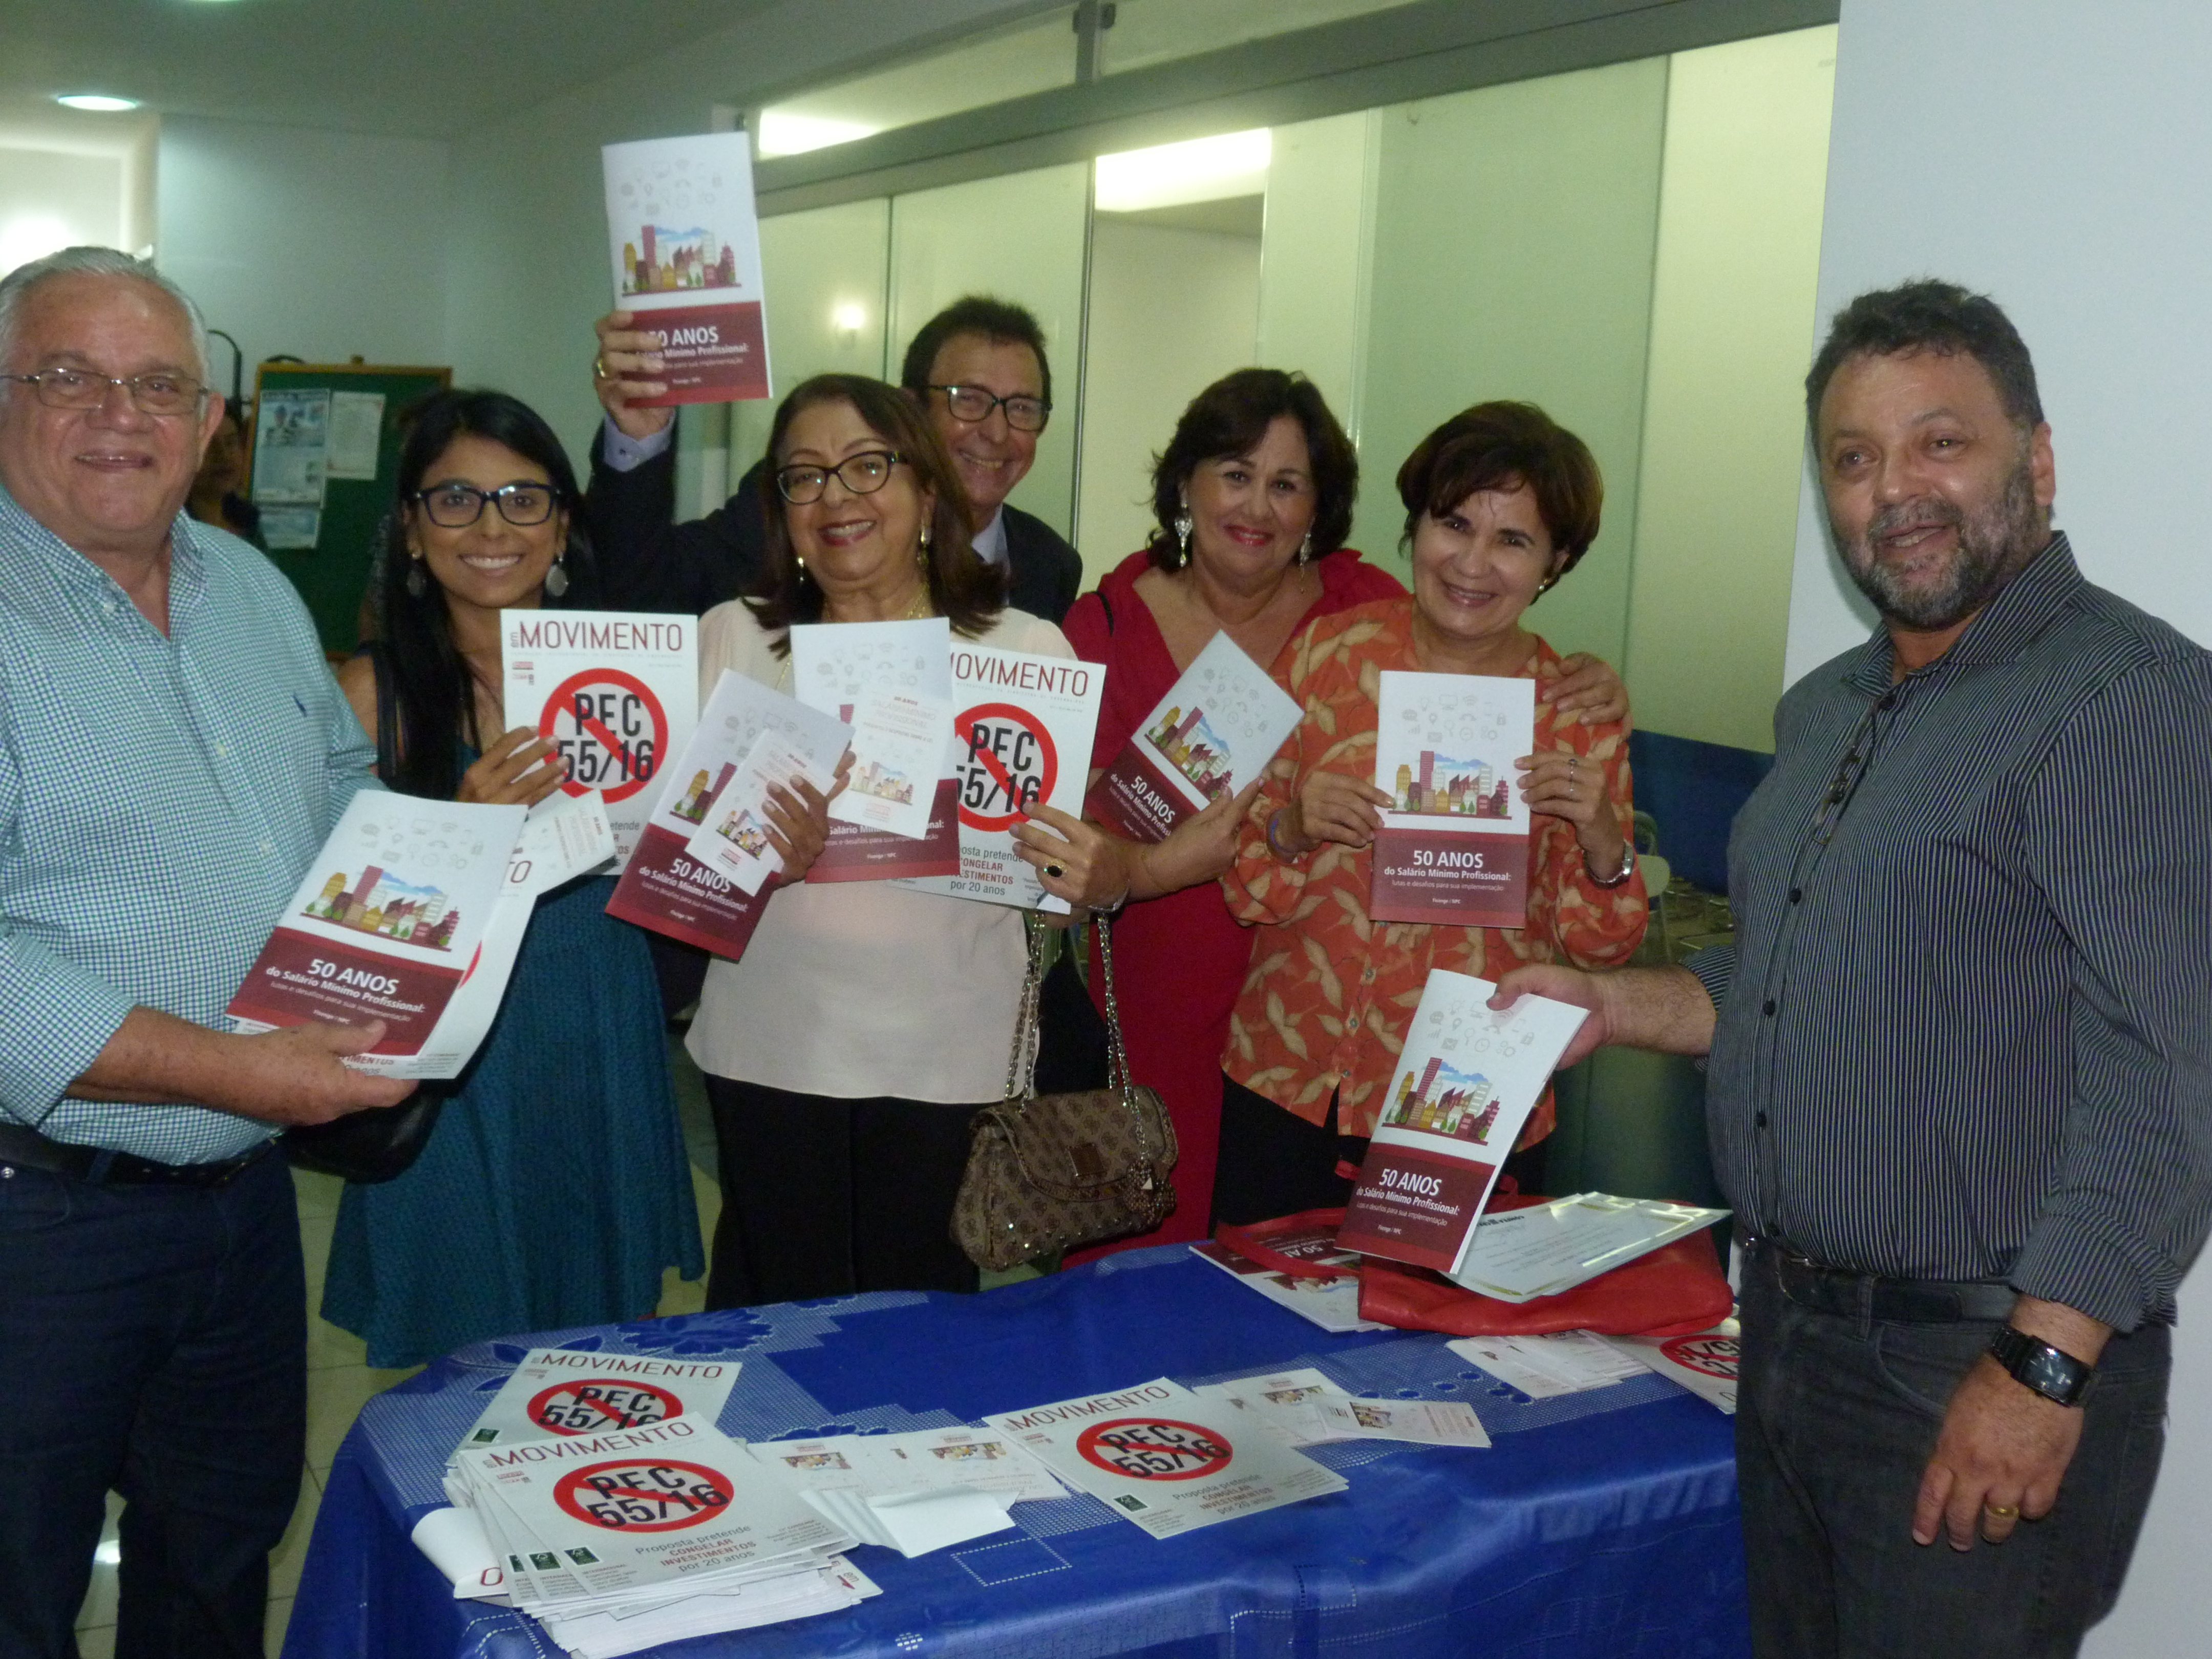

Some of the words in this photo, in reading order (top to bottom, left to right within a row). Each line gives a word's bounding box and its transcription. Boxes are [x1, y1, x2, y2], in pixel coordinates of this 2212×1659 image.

[672, 326, 719, 346] ANOS
[520, 621, 682, 651] MOVIMENTO
[950, 652, 1089, 696] OVIMENTO
[575, 692, 641, 736] PEC
[558, 740, 654, 783] 55/16
[968, 724, 1035, 772] PEC
[1131, 776, 1147, 794] 50
[1143, 791, 1175, 823] ANOS
[961, 846, 981, 857] osta
[961, 858, 1003, 871] ONGELAR
[1413, 850, 1433, 866] 50
[1436, 852, 1483, 868] ANOS
[639, 866, 651, 876] do
[669, 858, 691, 877] 50
[689, 867, 731, 892] ANOS
[1384, 866, 1395, 875] do
[1397, 867, 1426, 877] Salário
[1428, 868, 1459, 879] Mínimo
[1461, 870, 1512, 881] Profissional:
[951, 881, 966, 890] por
[969, 882, 981, 891] 20
[983, 886, 1005, 896] anos
[266, 966, 280, 977] do
[283, 970, 318, 987] Salário
[321, 980, 360, 998] Mínimo
[361, 991, 426, 1013] Profissional:
[307, 958, 336, 978] 50
[336, 967, 399, 995] ANOS
[1378, 1168, 1398, 1187] 50
[1396, 1172, 1442, 1196] ANOS
[1356, 1186, 1364, 1196] do
[1364, 1187, 1385, 1199] Salário
[1385, 1191, 1412, 1204] Mínimo
[1413, 1197, 1460, 1216] Profissional:
[541, 1353, 723, 1378] MOVIMENTO
[572, 1387, 656, 1412] PEC
[1006, 1386, 1169, 1430] MOVIMENTO
[489, 1421, 694, 1466] MOVIMENTO
[1099, 1424, 1185, 1454] PEC
[1112, 1439, 1230, 1478] 55/16
[585, 1466, 686, 1500] PEC
[586, 1484, 730, 1527] 55/16
[635, 1539, 694, 1555] Proposta
[696, 1525, 752, 1543] pretende
[660, 1541, 757, 1566] INVESTIMENTOS
[669, 1538, 733, 1557] CONGELAR
[678, 1562, 700, 1572] por
[703, 1558, 721, 1567] 20
[723, 1550, 755, 1563] anos
